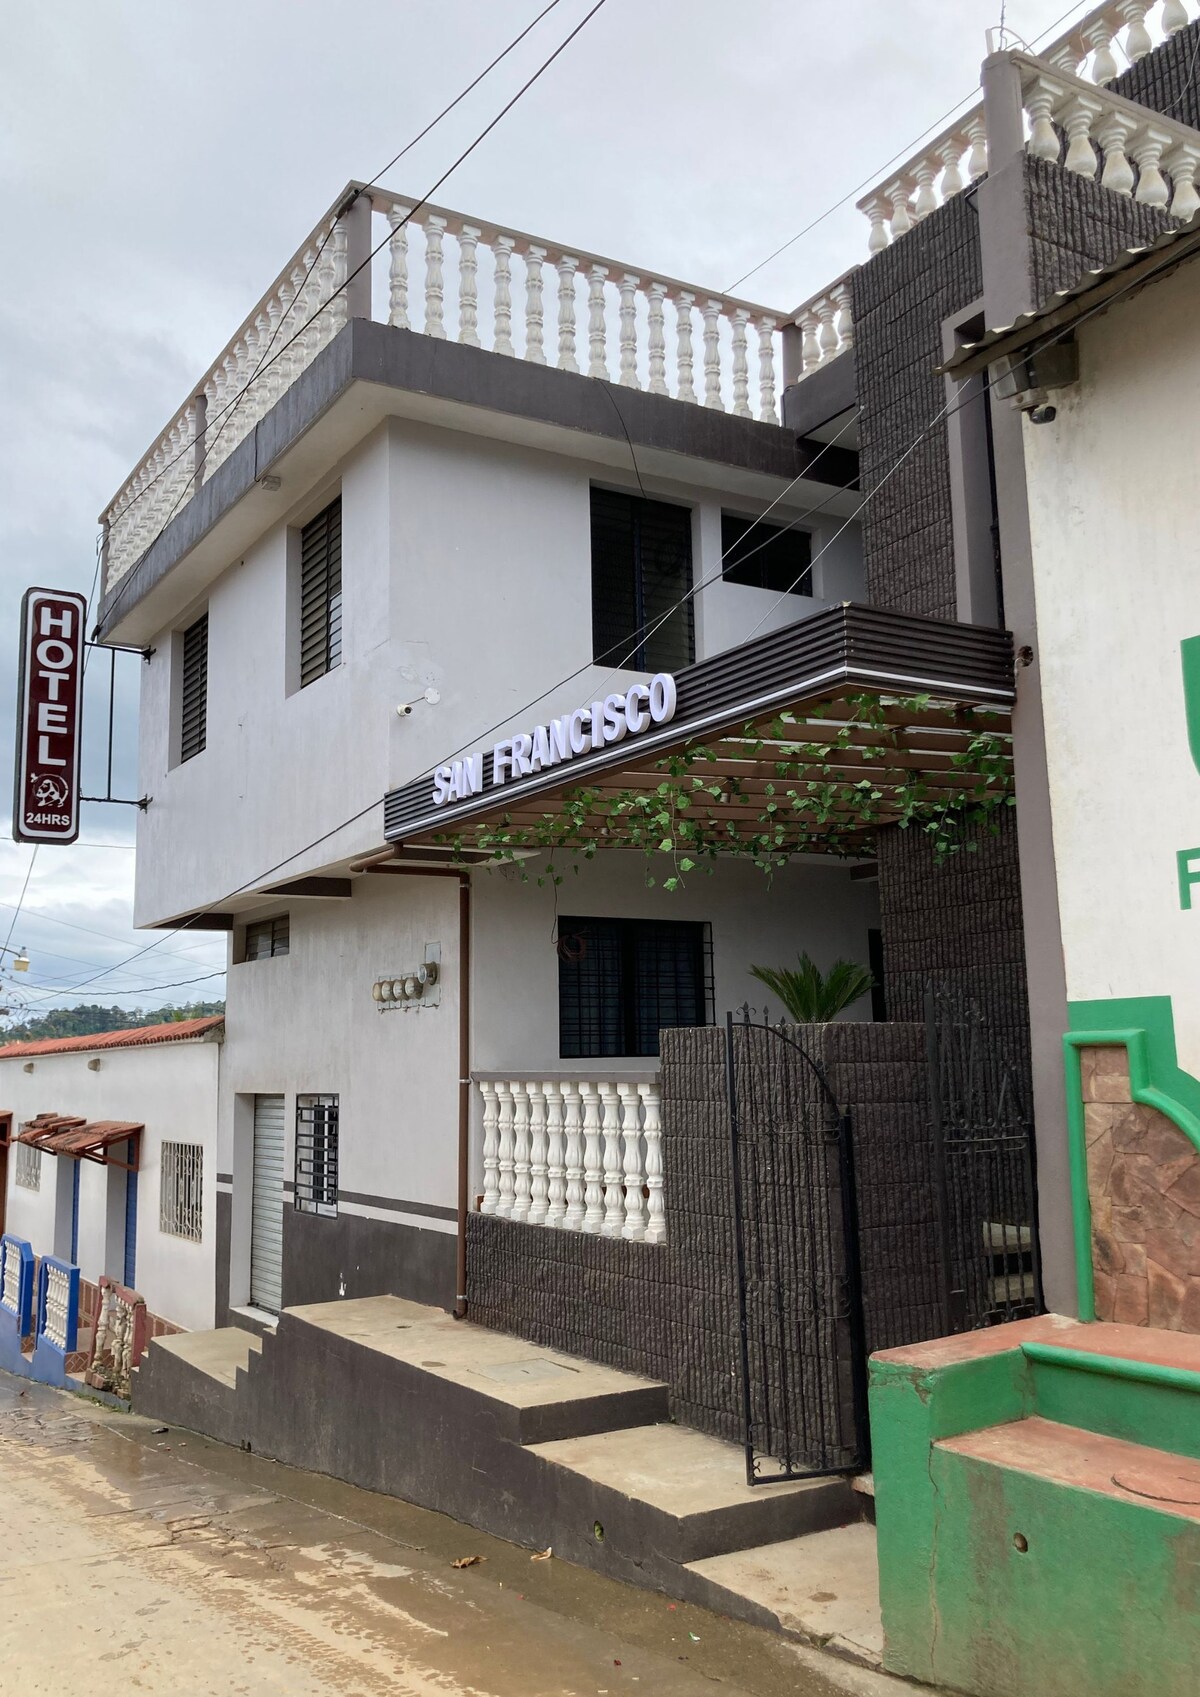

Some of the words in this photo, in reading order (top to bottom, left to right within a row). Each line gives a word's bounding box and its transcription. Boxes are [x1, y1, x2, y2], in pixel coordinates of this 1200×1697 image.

[36, 606, 73, 766] HOTEL
[432, 753, 484, 805] SAN
[493, 672, 677, 784] FRANCISCO
[26, 812, 70, 826] 24HRS
